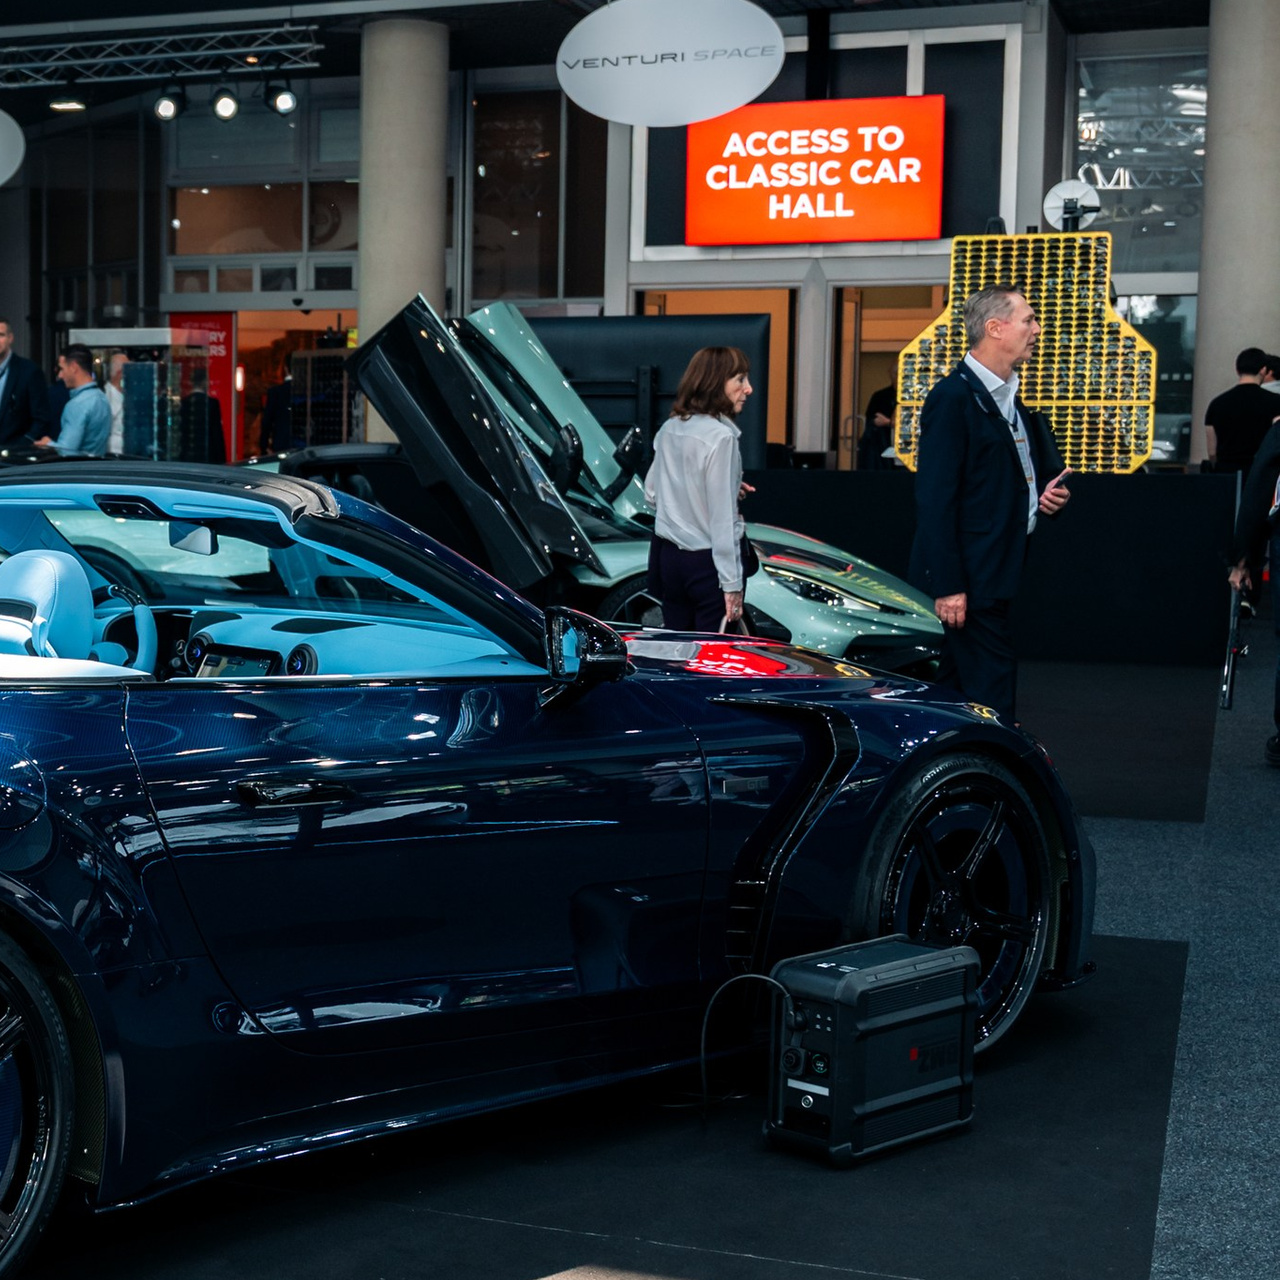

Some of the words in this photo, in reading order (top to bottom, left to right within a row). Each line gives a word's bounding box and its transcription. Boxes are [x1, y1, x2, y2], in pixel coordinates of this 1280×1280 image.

[562, 51, 685, 70] VENTURI
[692, 45, 778, 62] SPACE
[722, 127, 850, 158] ACCESS
[857, 124, 905, 152] TO
[705, 160, 842, 191] CLASSIC
[849, 156, 922, 185] CAR
[769, 191, 855, 220] HALL
